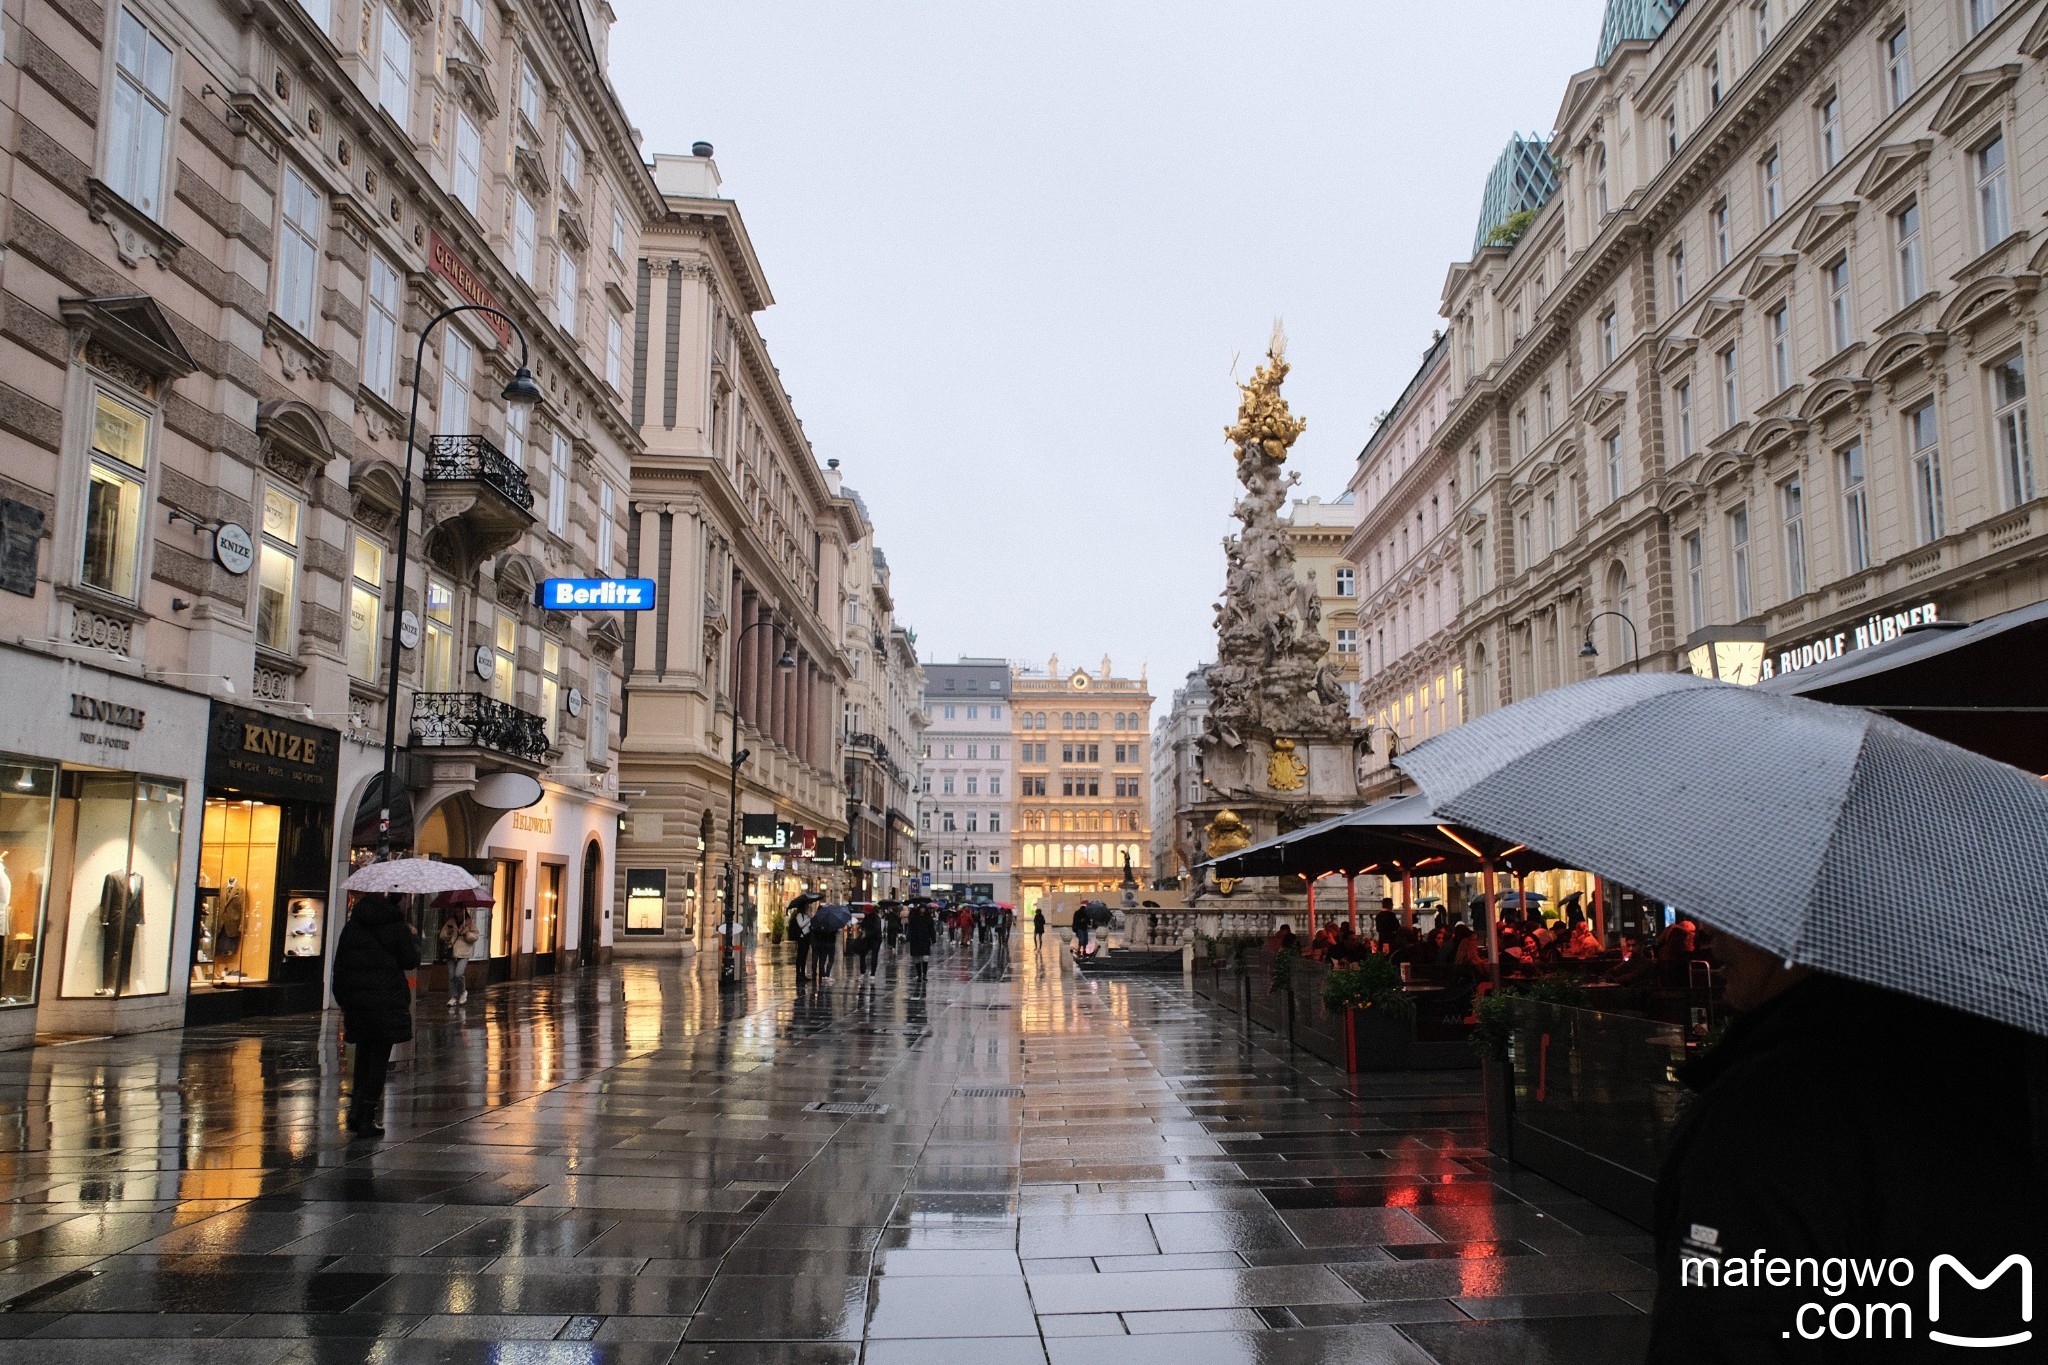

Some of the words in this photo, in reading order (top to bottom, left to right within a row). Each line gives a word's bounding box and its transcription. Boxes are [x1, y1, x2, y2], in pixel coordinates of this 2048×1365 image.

[220, 537, 251, 559] KNIZE
[556, 581, 642, 604] Berlitz
[1780, 632, 1846, 675] RUDOLF
[1854, 602, 1938, 651] HÜBNER
[70, 693, 146, 731] KNIZE
[243, 723, 317, 765] KNIZE
[513, 811, 552, 835] HELDWEIN
